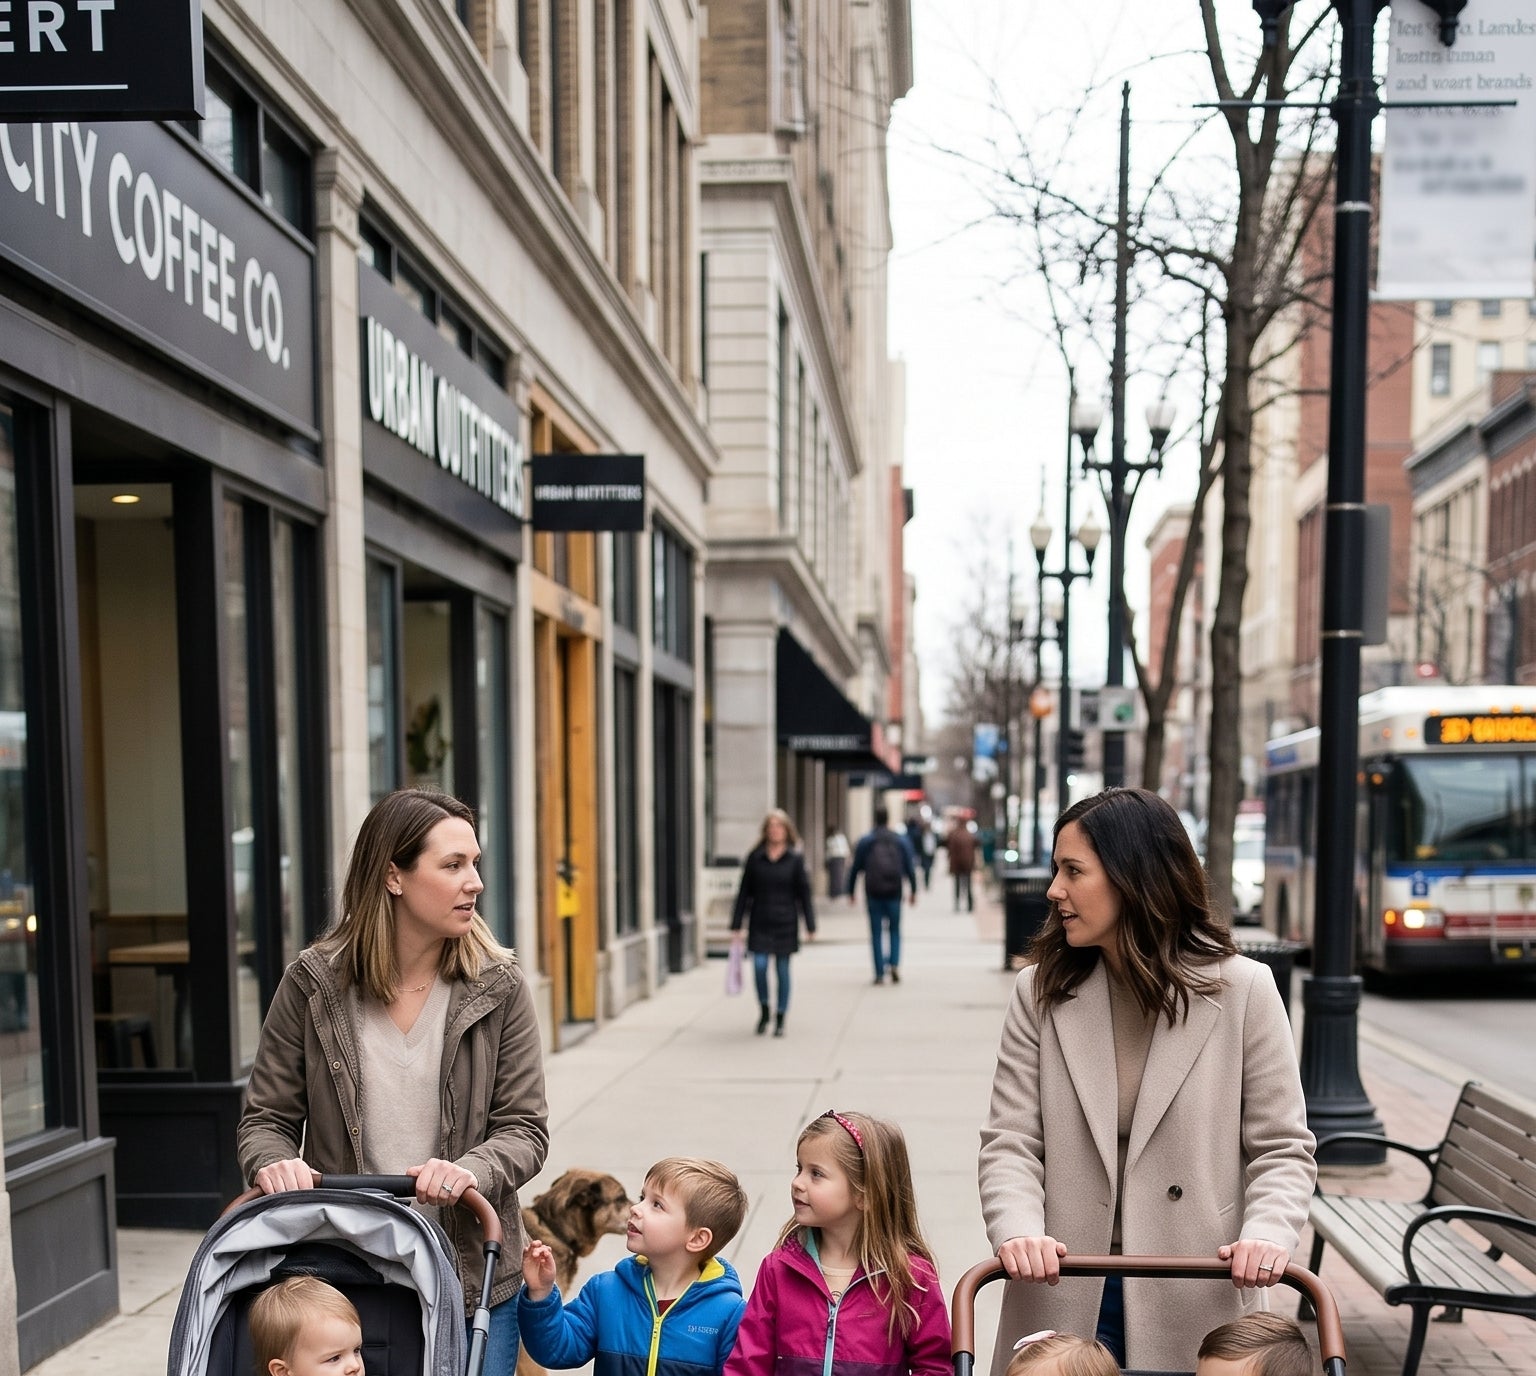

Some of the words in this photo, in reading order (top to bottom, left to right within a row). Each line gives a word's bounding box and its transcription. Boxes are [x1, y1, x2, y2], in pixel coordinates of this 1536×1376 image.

[107, 151, 238, 335] COFFEE
[243, 256, 290, 371] CO.
[367, 314, 436, 459] URBAN
[436, 374, 524, 519] OUTFITTERS
